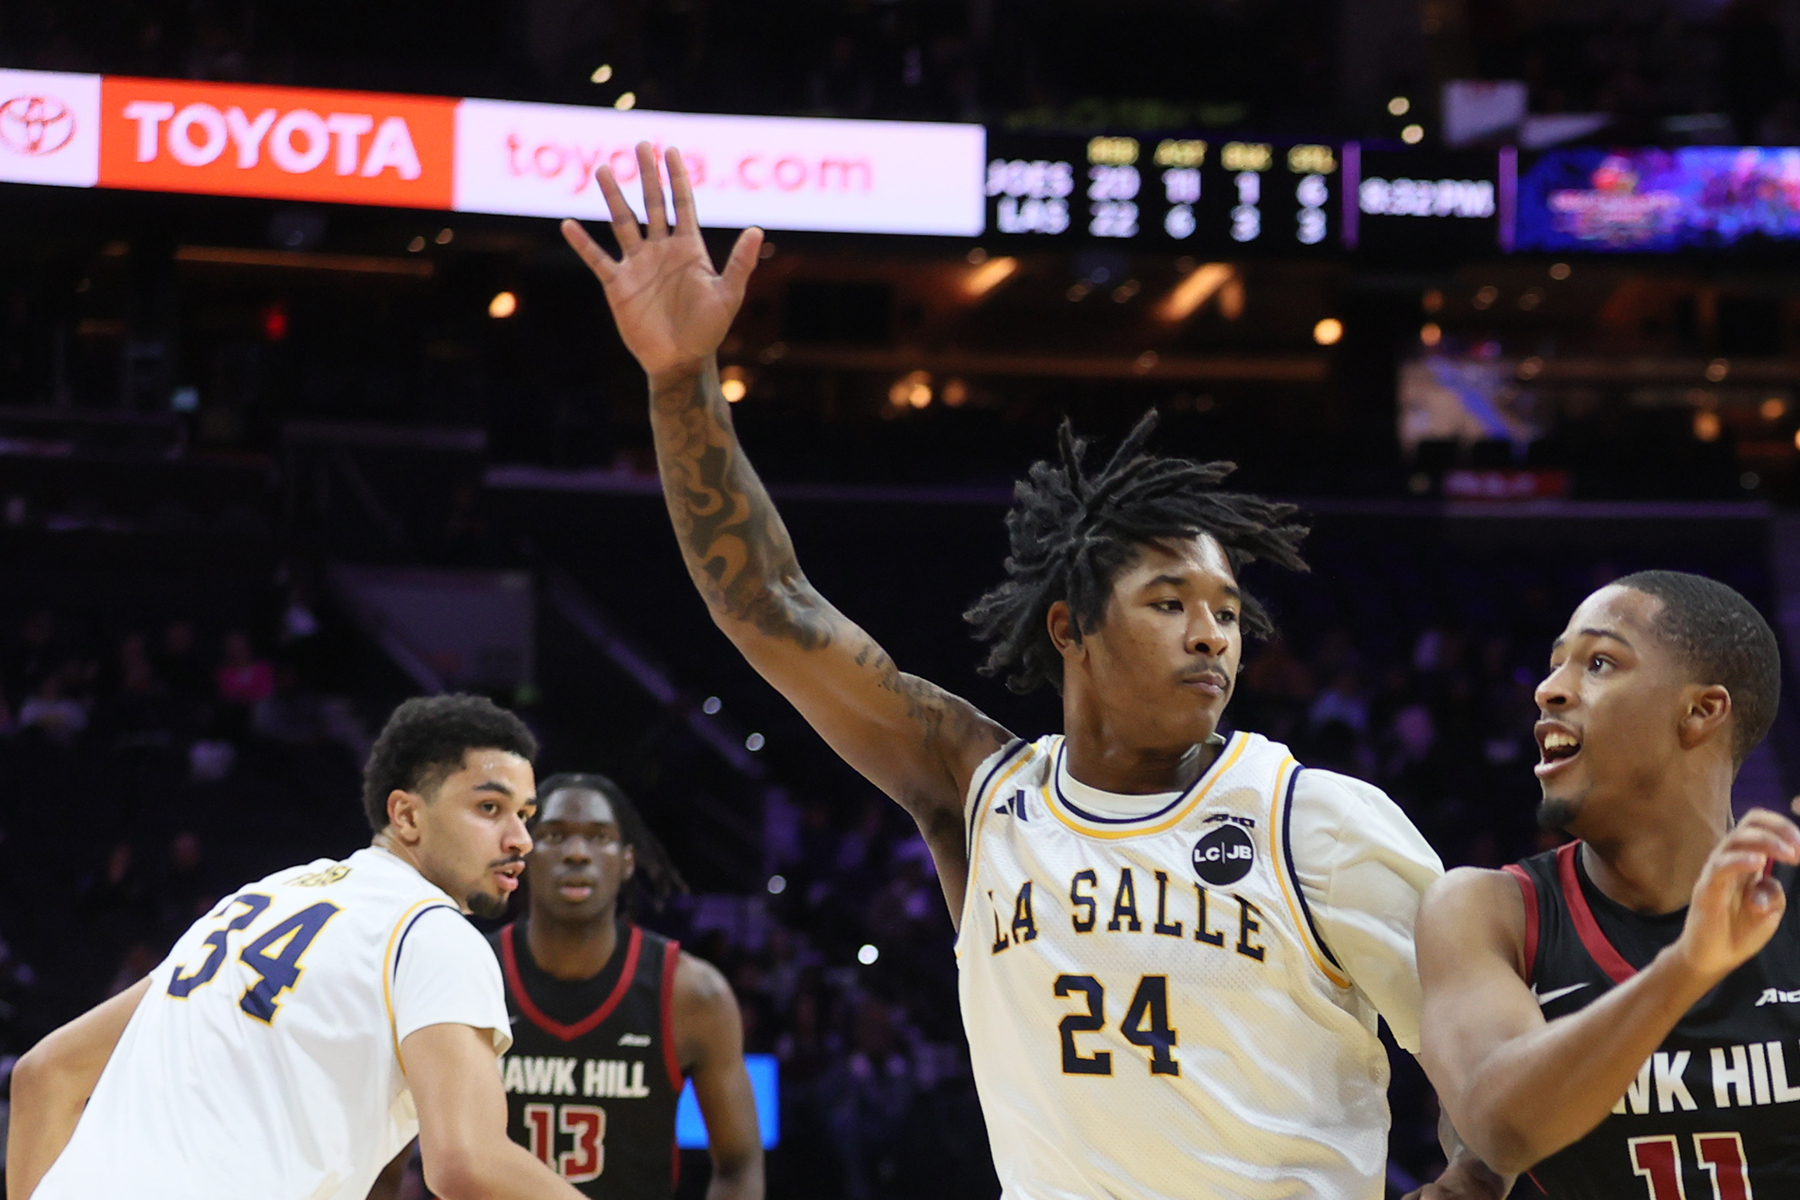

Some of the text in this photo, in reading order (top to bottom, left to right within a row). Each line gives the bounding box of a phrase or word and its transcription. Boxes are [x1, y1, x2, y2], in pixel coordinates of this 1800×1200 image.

[123, 101, 422, 181] TOYOTA
[1230, 204, 1262, 242] 3
[1297, 206, 1328, 245] 3
[988, 867, 1266, 963] LA SALLE
[166, 893, 344, 1027] 34
[1053, 973, 1180, 1077] 24
[582, 1058, 651, 1099] HILL
[1611, 1050, 1698, 1115] WK
[524, 1103, 607, 1184] 13
